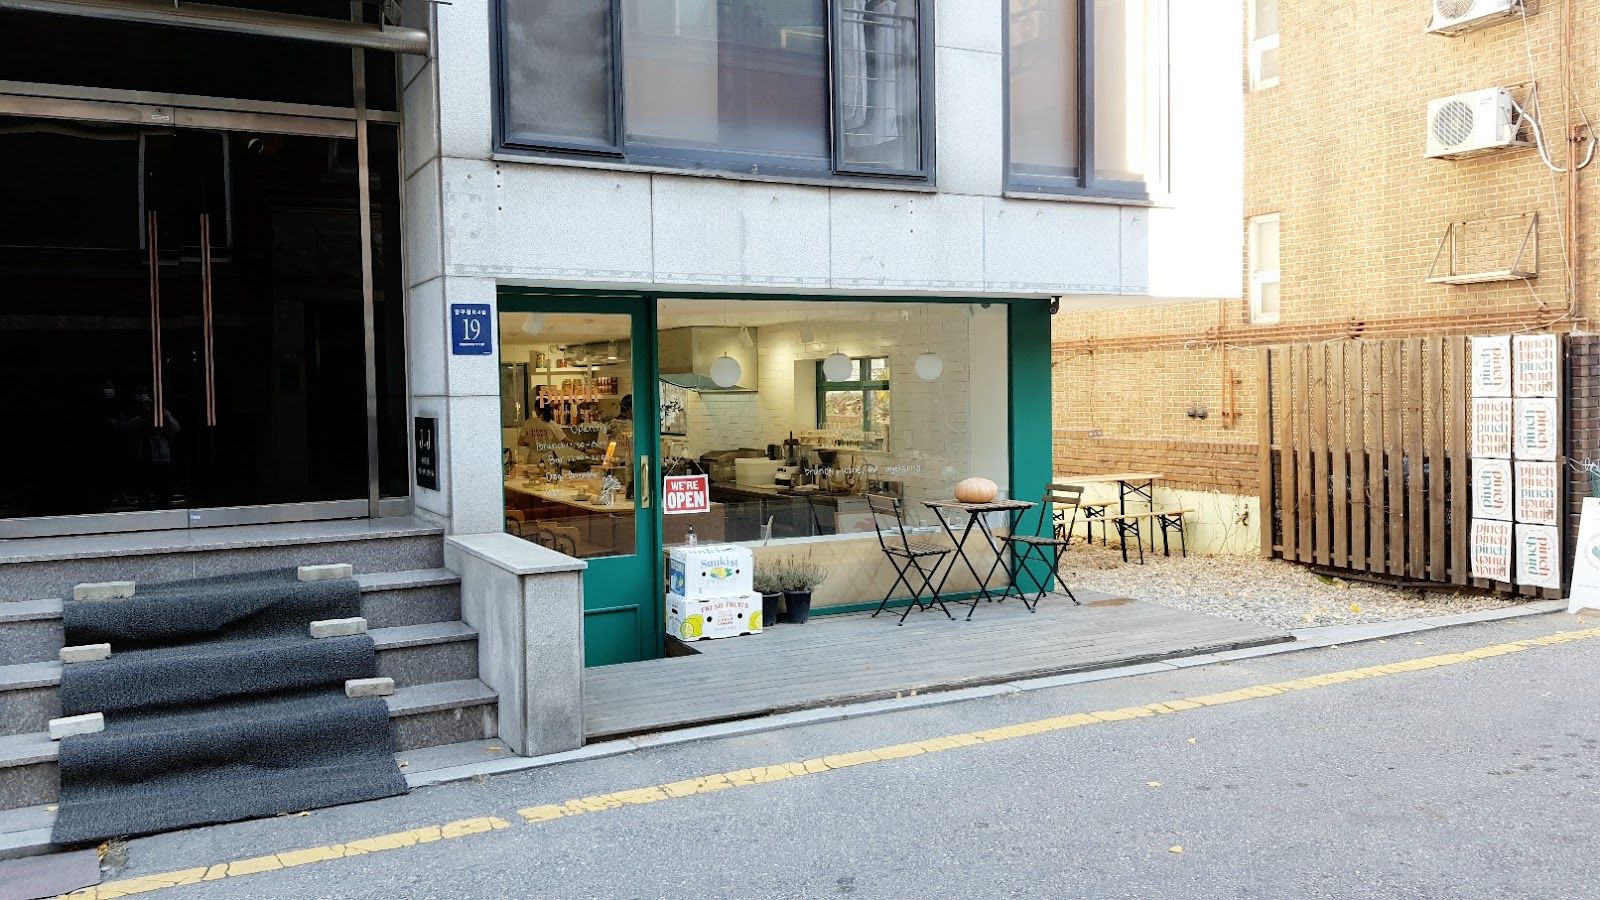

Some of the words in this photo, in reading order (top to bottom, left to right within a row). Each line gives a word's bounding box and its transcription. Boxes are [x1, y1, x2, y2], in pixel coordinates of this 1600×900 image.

[463, 319, 481, 340] 19
[1519, 338, 1553, 350] pinch
[1520, 349, 1553, 361] pinch
[1519, 360, 1553, 372] pinch
[1477, 401, 1508, 412] pinch
[1477, 412, 1508, 423] pinch
[1477, 422, 1508, 433] pinch
[1521, 465, 1553, 476] pinch
[671, 480, 699, 490] WE'RE
[1521, 476, 1554, 487] pinch
[1521, 487, 1554, 498] pinch
[668, 491, 705, 509] OPEN
[1476, 522, 1508, 534] pinch
[1476, 533, 1507, 545] pinch
[1476, 544, 1507, 556] pinch
[700, 556, 739, 569] Sunkist
[701, 602, 724, 613] FRESH
[725, 601, 749, 609] FRUITS
